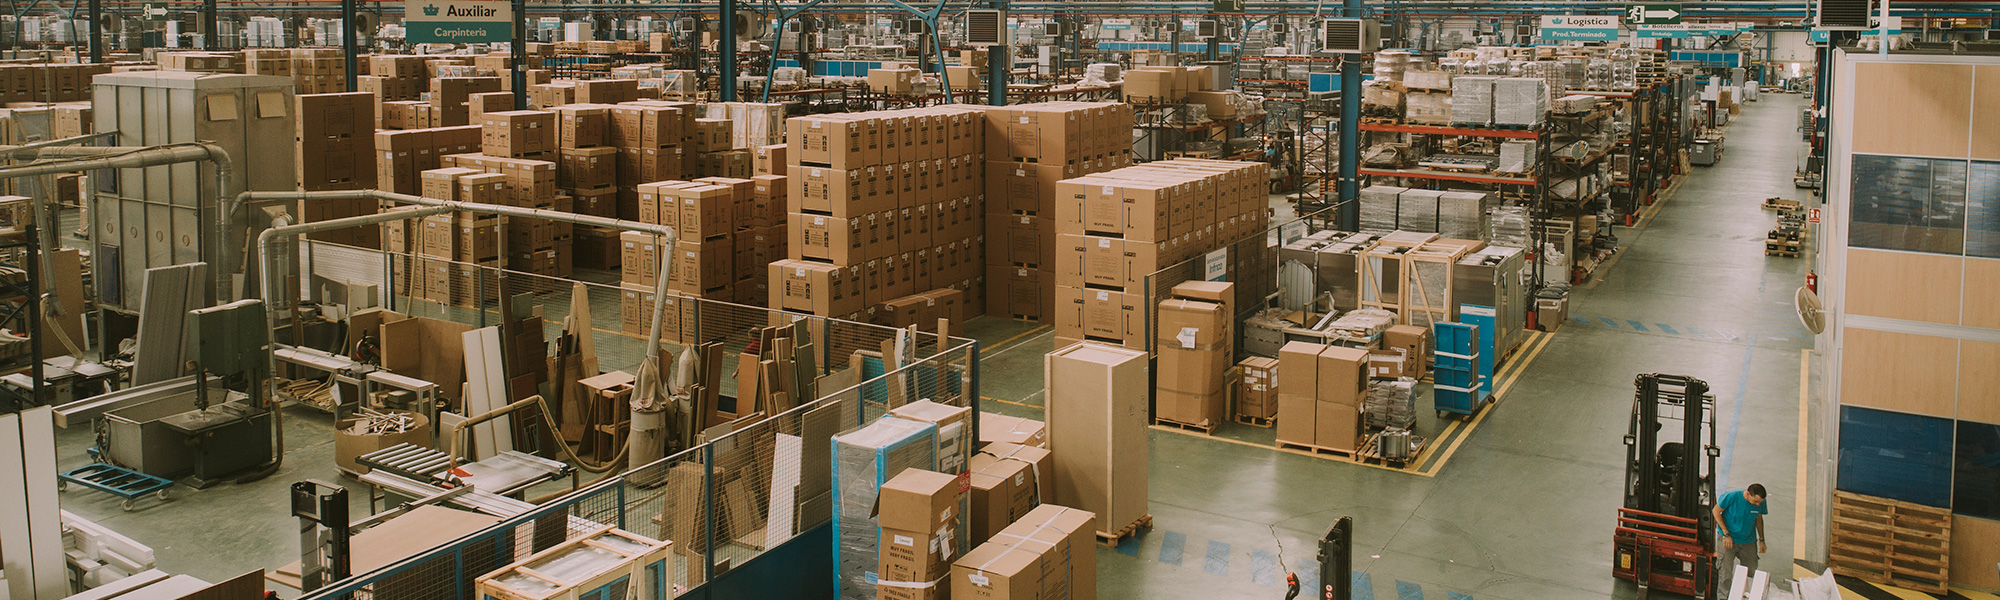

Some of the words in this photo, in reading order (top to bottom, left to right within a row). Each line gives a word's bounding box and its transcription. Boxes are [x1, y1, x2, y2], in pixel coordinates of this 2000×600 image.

[447, 5, 497, 17] Auxiliar
[1567, 17, 1609, 27] Logistica
[434, 27, 487, 39] Carpinteria
